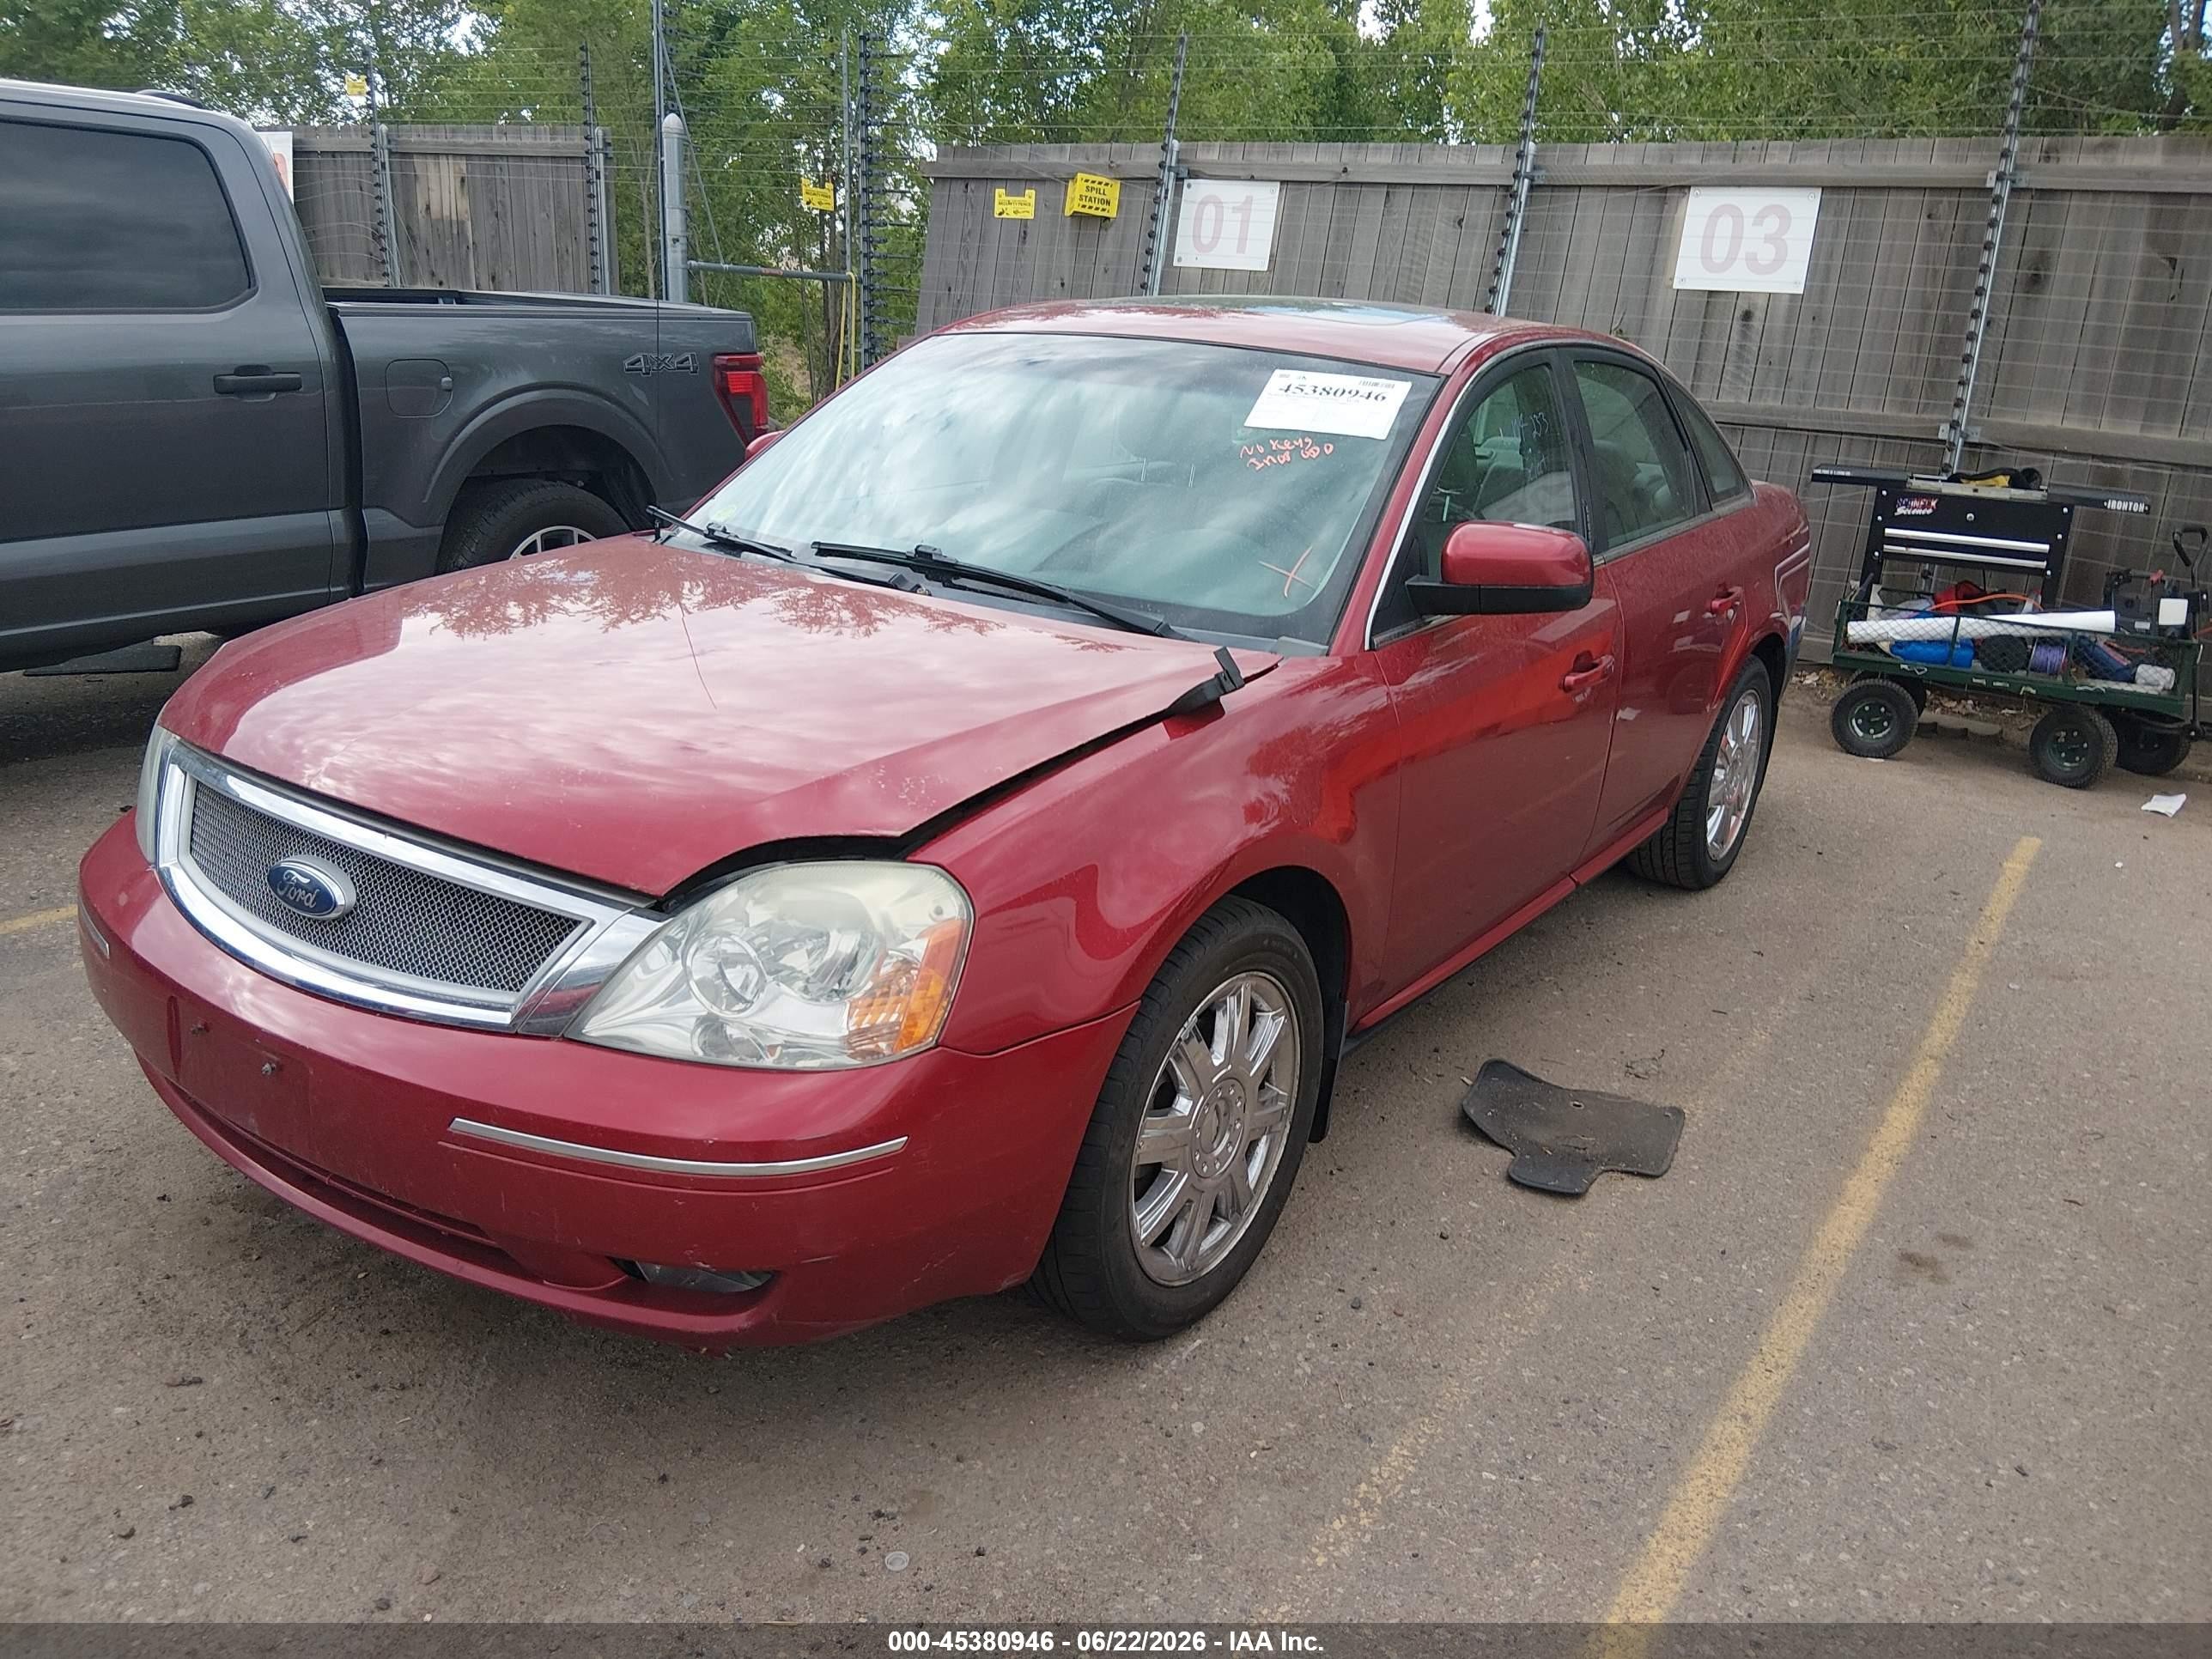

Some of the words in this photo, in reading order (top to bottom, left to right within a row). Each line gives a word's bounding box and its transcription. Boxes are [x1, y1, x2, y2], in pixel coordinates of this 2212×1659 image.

[1079, 194, 1111, 207] STATION
[1085, 185, 1107, 197] SPILL
[1192, 194, 1254, 255] 01
[1700, 204, 1793, 276] 03
[1277, 382, 1389, 404] 45380946
[2106, 499, 2145, 514] IRONTON
[276, 869, 320, 908] Ford
